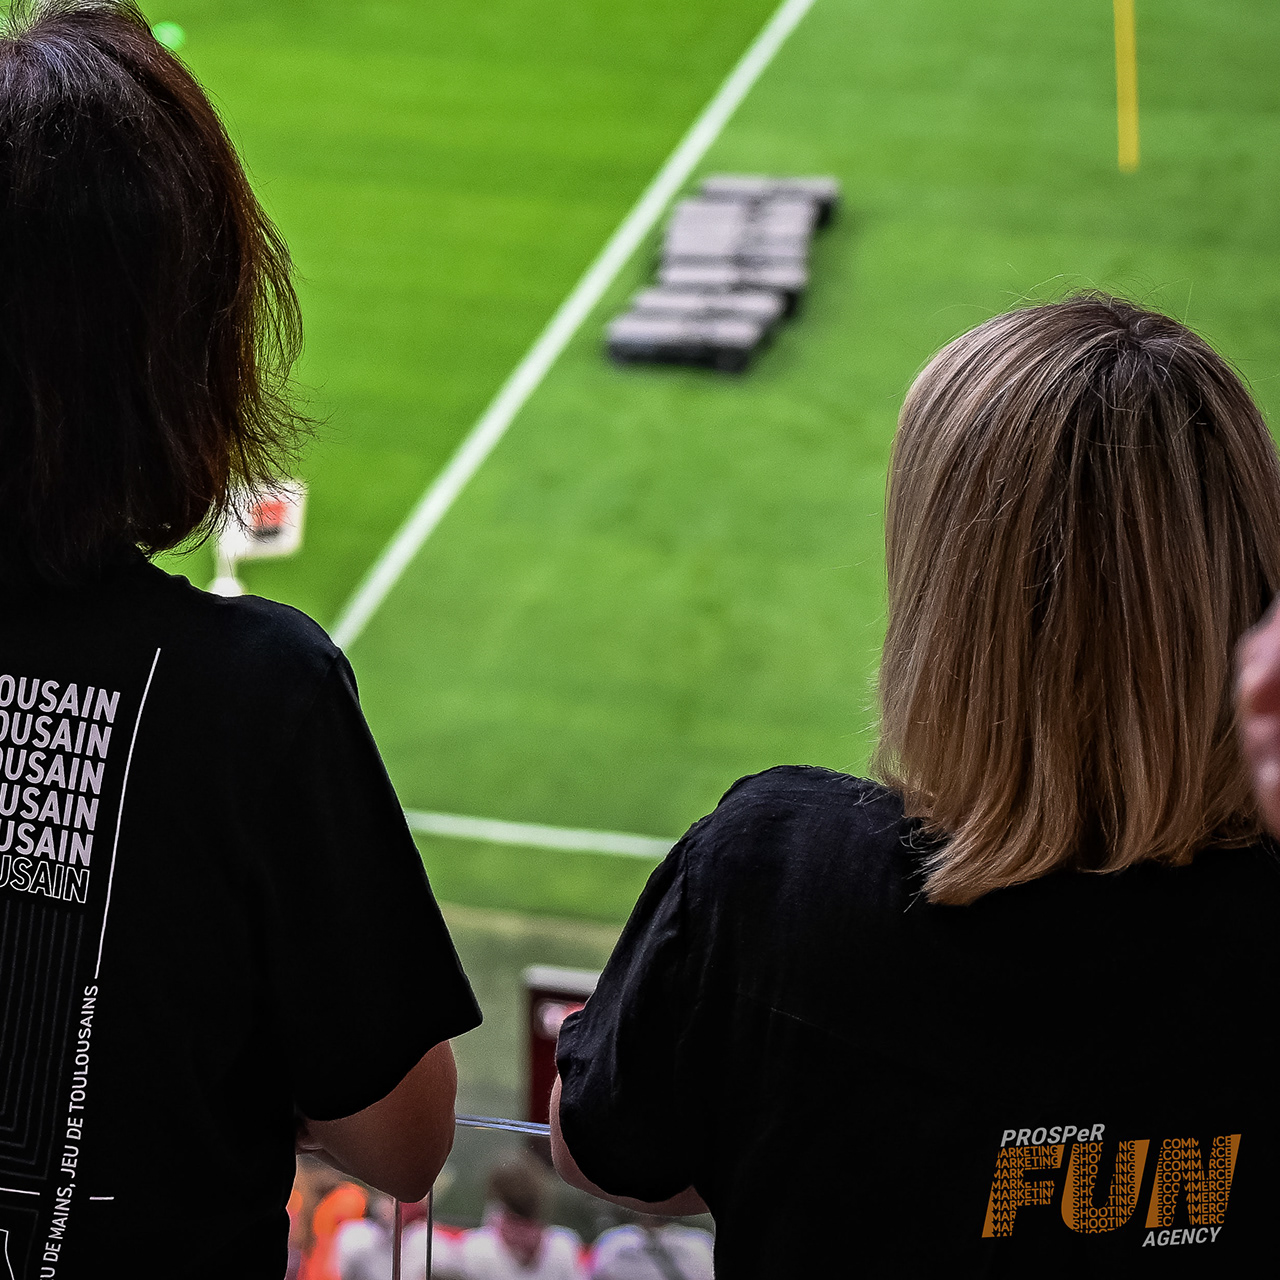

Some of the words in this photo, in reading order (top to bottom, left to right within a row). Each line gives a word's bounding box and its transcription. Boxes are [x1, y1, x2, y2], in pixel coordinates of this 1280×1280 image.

[68, 985, 99, 1113] TOULOUSAINS
[65, 1117, 83, 1140] DE
[60, 1144, 79, 1179] JEU
[981, 1133, 1242, 1238] FUN
[48, 1183, 76, 1240] MAINS,
[1073, 1217, 1130, 1229] SHOOTIN
[1141, 1226, 1223, 1248] AGENCY
[42, 1242, 61, 1262] DE
